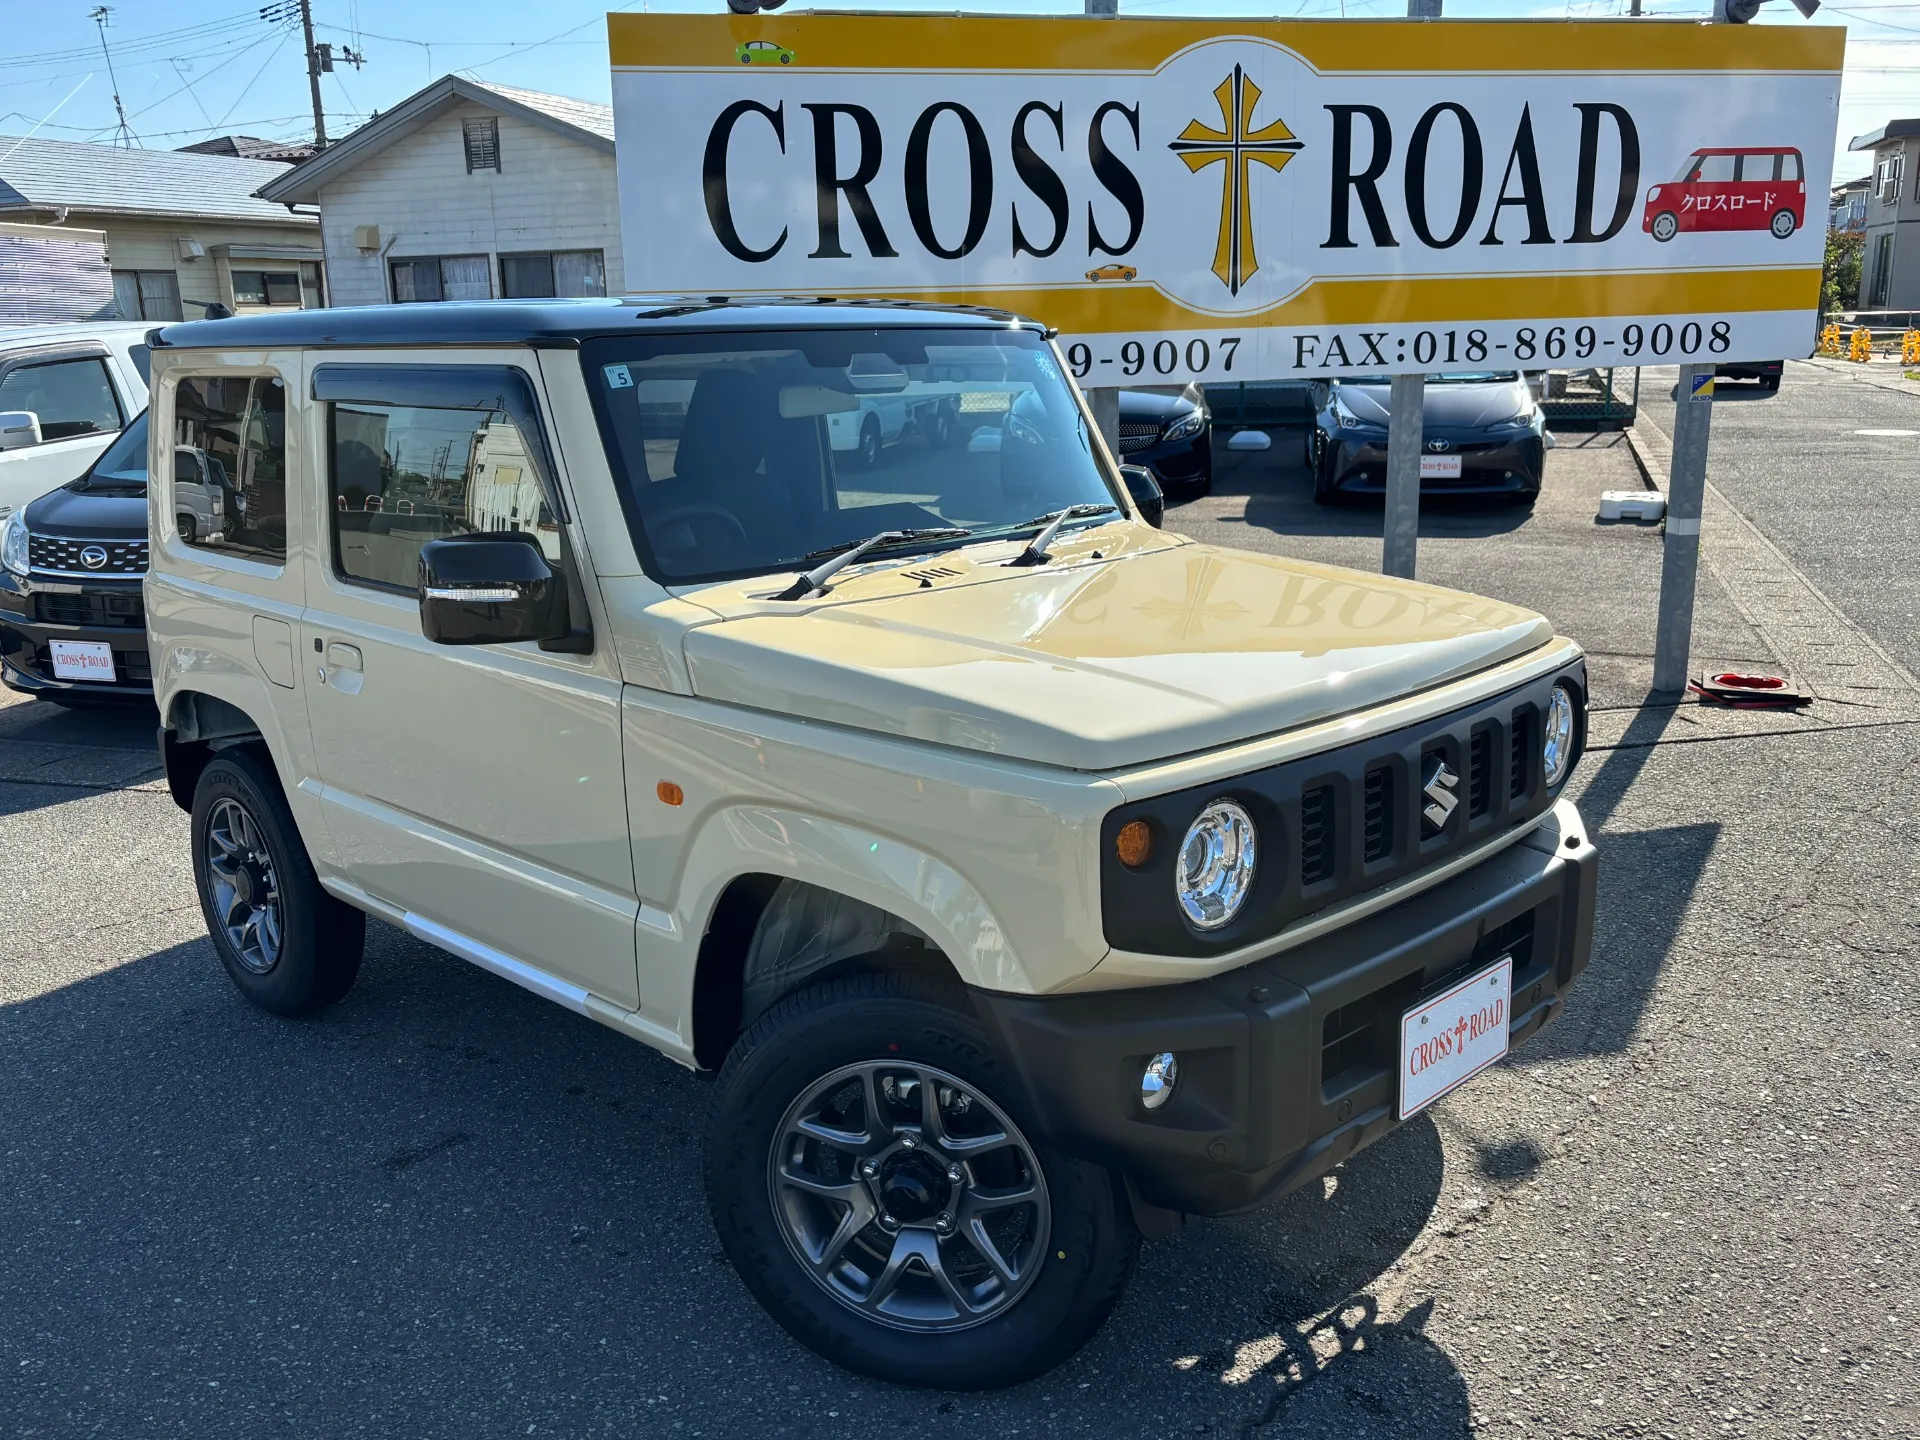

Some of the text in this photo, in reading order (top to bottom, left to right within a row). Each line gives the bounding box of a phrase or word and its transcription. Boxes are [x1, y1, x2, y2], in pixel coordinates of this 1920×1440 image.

[702, 99, 1640, 263] CROSS ROAD
[1680, 191, 1777, 214] クロスロード
[1291, 320, 1731, 369] FAX:018-869-9008
[618, 373, 627, 385] 5
[57, 653, 108, 668] CROSS ROAD
[1410, 998, 1504, 1076] CROSS ROAD
